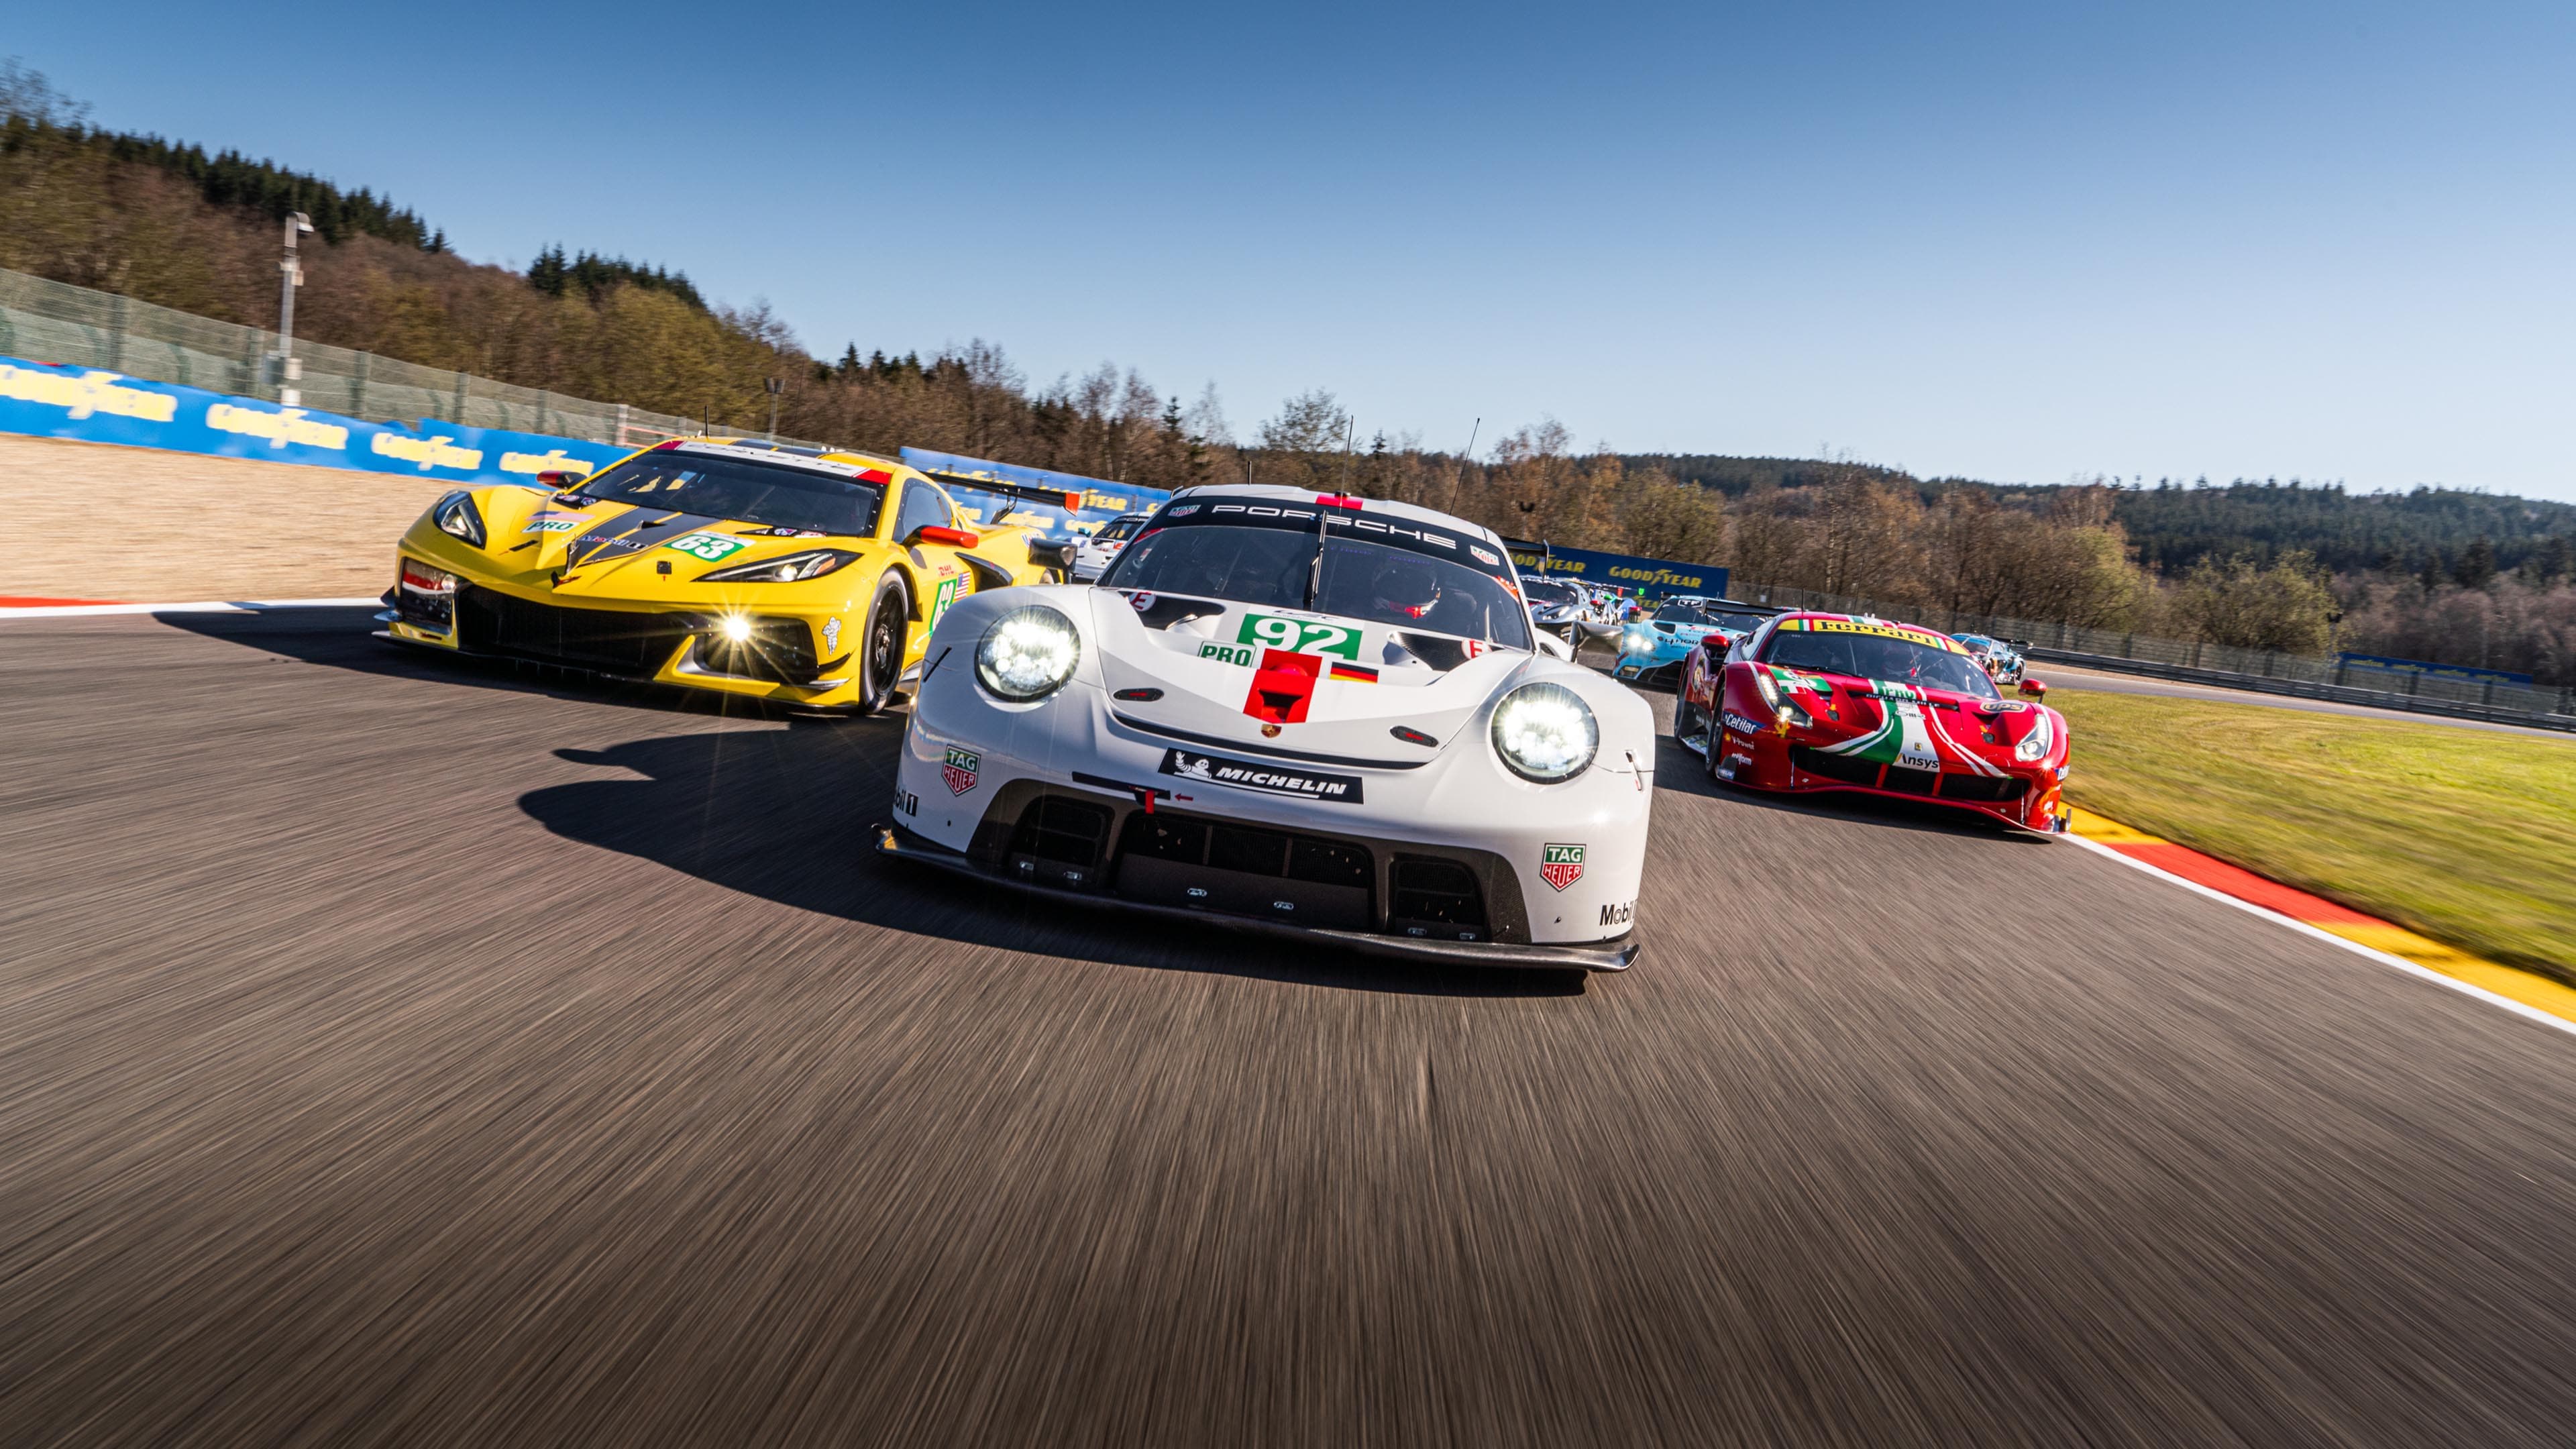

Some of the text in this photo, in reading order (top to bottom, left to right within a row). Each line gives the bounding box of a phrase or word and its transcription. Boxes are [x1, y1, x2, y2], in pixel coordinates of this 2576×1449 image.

[527, 521, 574, 532] PRO
[1212, 504, 1456, 550] PORSCHE
[671, 535, 735, 559] 63
[1608, 566, 1702, 588] GOODYEAR
[1129, 591, 1152, 610] E
[1252, 618, 1348, 660] 92
[1819, 621, 1933, 644] Ferrari
[1201, 645, 1252, 667] PRO
[948, 749, 977, 771] TAG
[1895, 753, 1939, 769] Ansys
[944, 767, 975, 792] HEUER
[1216, 767, 1348, 794] MICHELIN
[1548, 847, 1582, 863] TAG
[1544, 865, 1581, 887] HEUER
